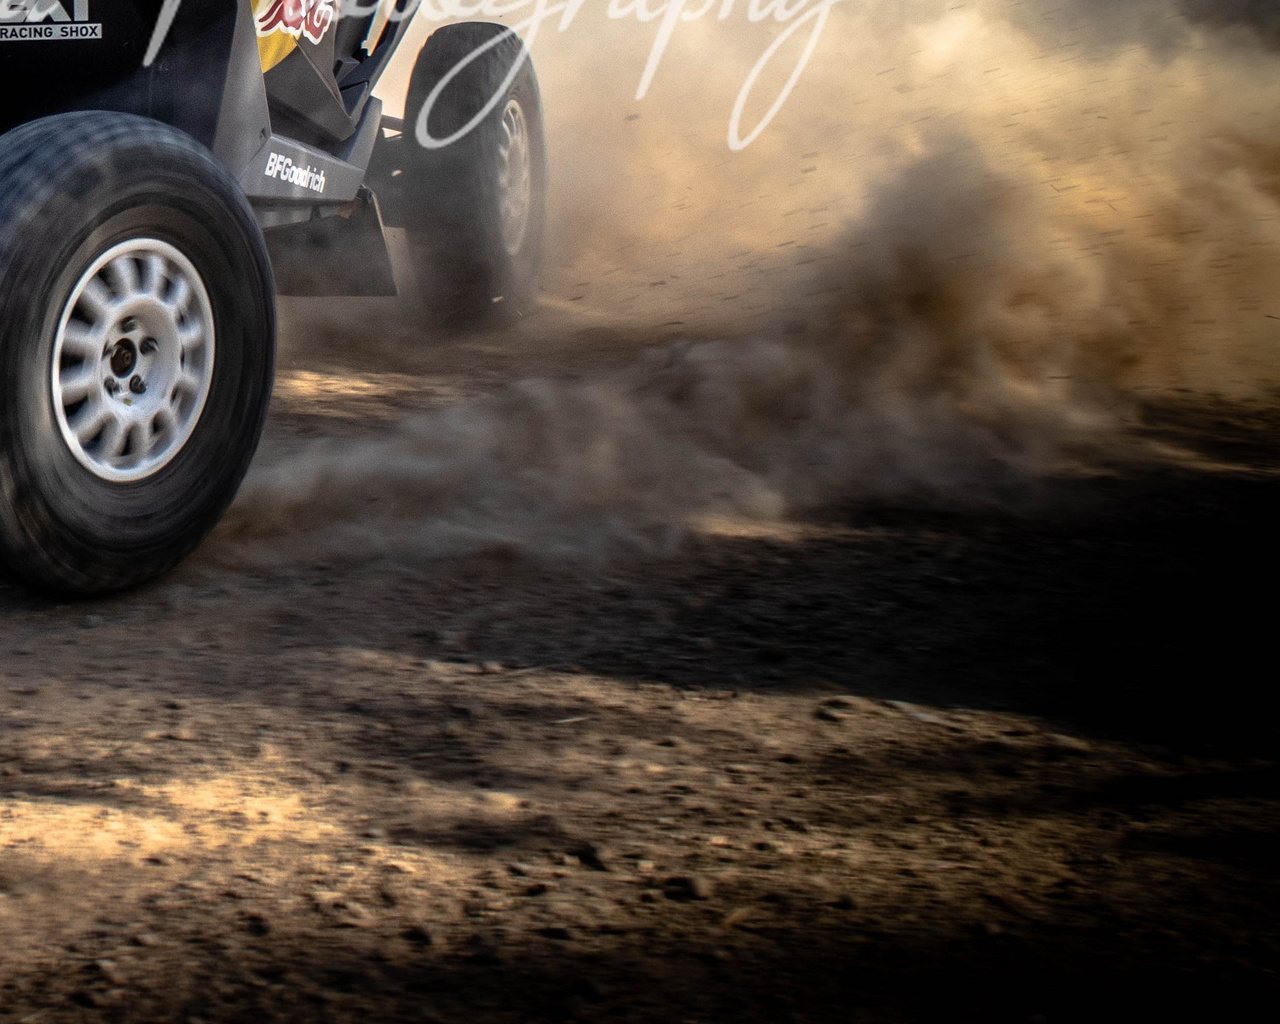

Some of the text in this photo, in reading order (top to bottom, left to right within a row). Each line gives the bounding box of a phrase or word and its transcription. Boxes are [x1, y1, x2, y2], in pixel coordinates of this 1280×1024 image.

[0, 25, 98, 39] RACING SHOX
[264, 152, 326, 194] BFGoodrich
